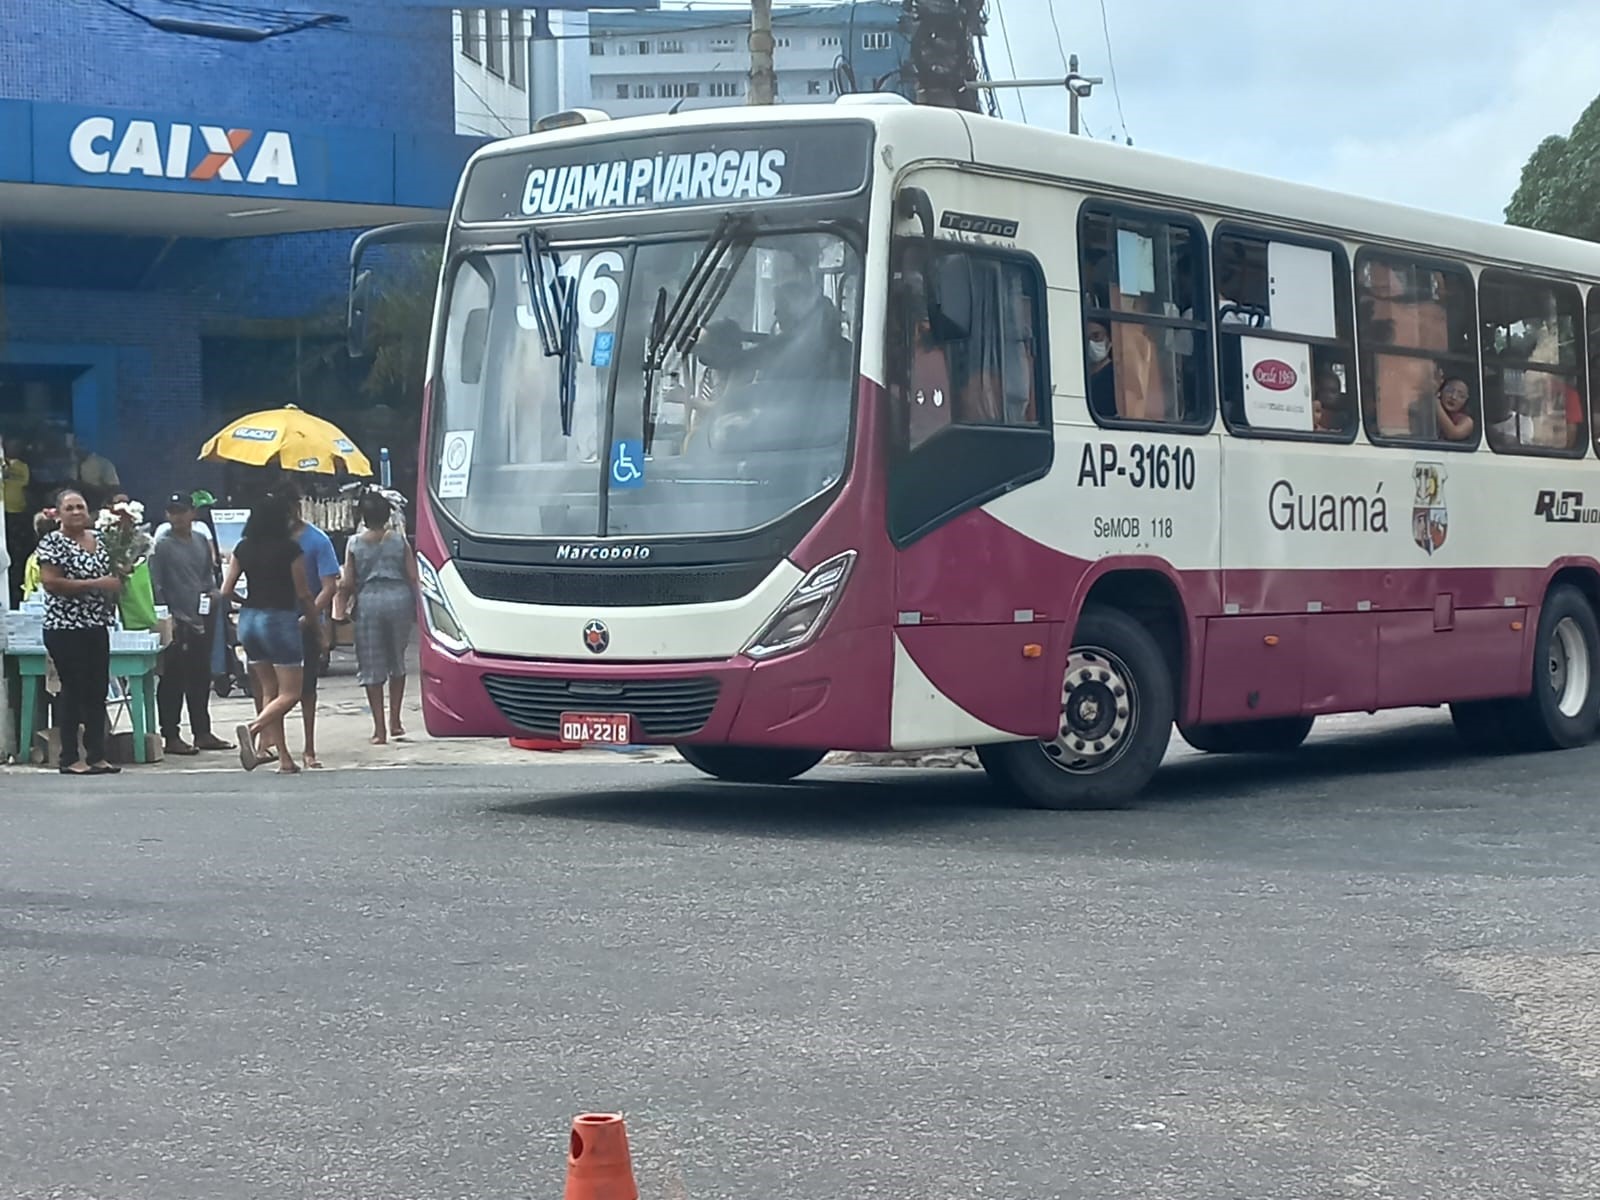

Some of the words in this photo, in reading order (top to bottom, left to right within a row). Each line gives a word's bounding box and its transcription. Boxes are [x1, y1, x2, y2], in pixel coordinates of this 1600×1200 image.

[69, 116, 298, 186] CAIXA
[945, 213, 1016, 236] Torino
[1077, 442, 1195, 491] AP-31610
[1268, 479, 1389, 533] Guamá
[1093, 516, 1140, 538] SeMOB
[1151, 517, 1173, 538] 118
[556, 544, 650, 560] Marcopolo
